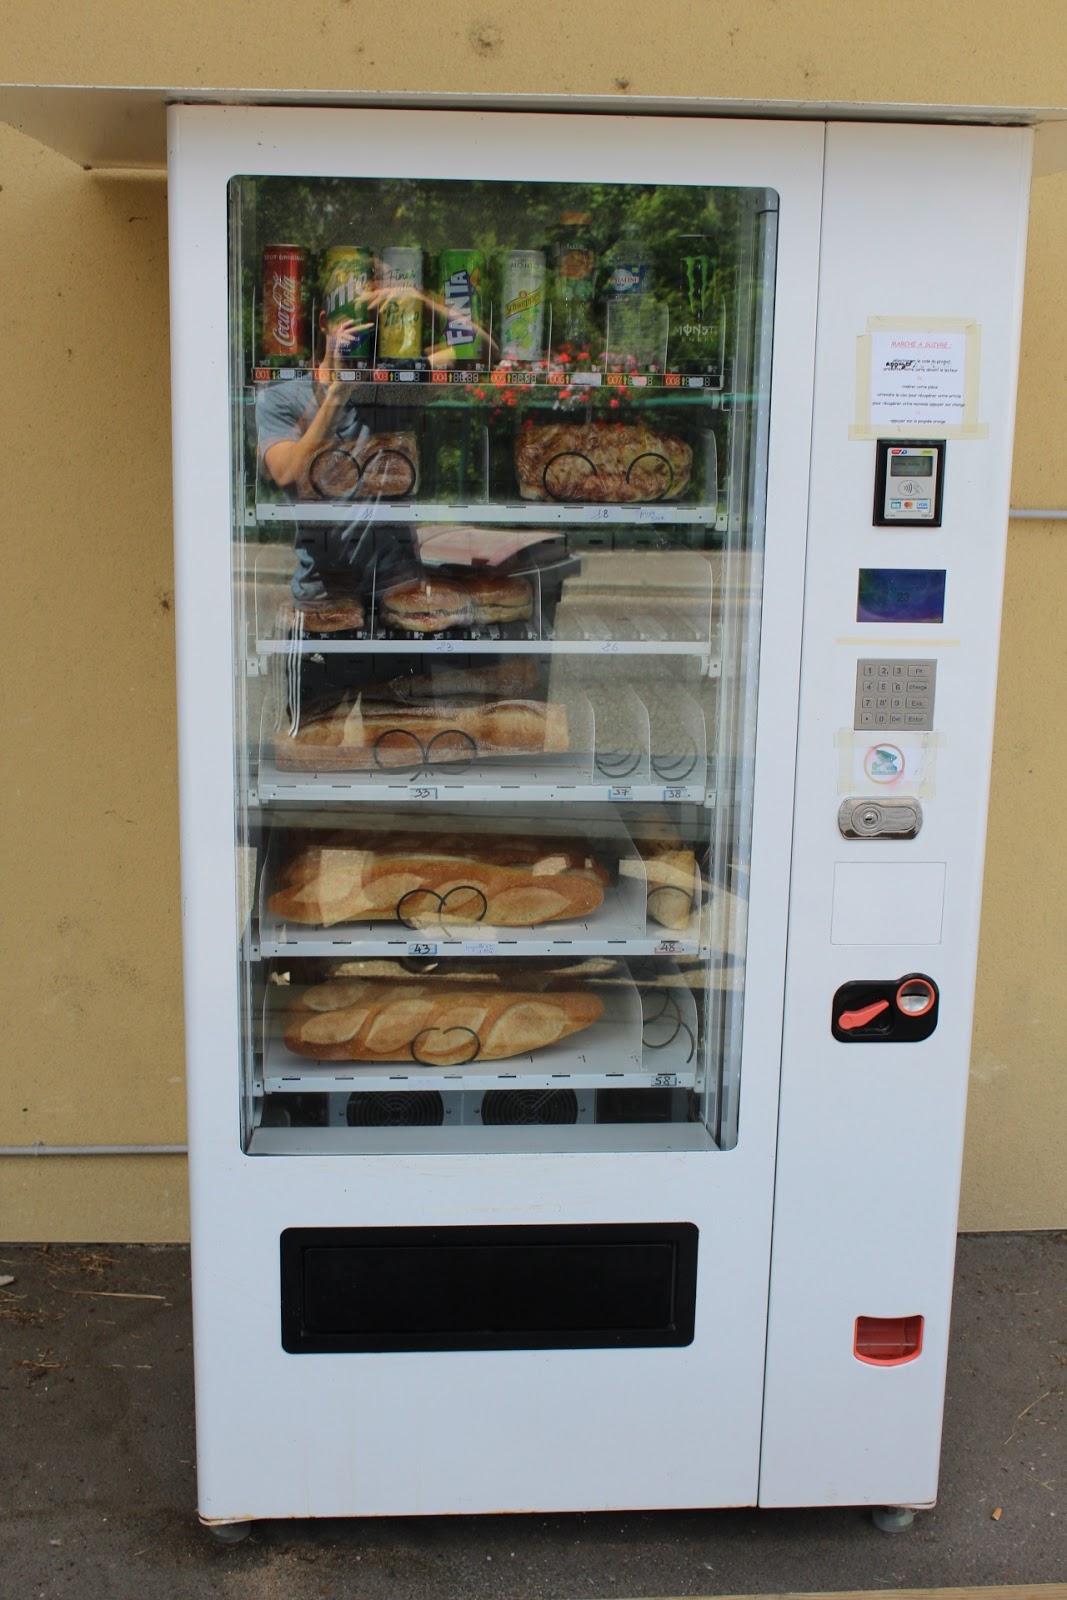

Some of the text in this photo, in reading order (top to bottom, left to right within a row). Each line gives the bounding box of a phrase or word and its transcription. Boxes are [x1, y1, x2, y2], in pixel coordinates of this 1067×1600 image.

[445, 270, 475, 346] FANTA
[255, 371, 270, 379] 001
[373, 371, 388, 380] 003
[432, 373, 447, 381] 004
[491, 373, 506, 382] 005
[550, 374, 565, 383] 006
[608, 375, 623, 384] 007
[665, 376, 680, 384] 008
[414, 788, 430, 798] 33
[612, 788, 630, 796] 37
[668, 790, 681, 798] 38
[414, 944, 431, 954] 43
[660, 942, 676, 952] 48
[655, 1076, 671, 1086] 58
